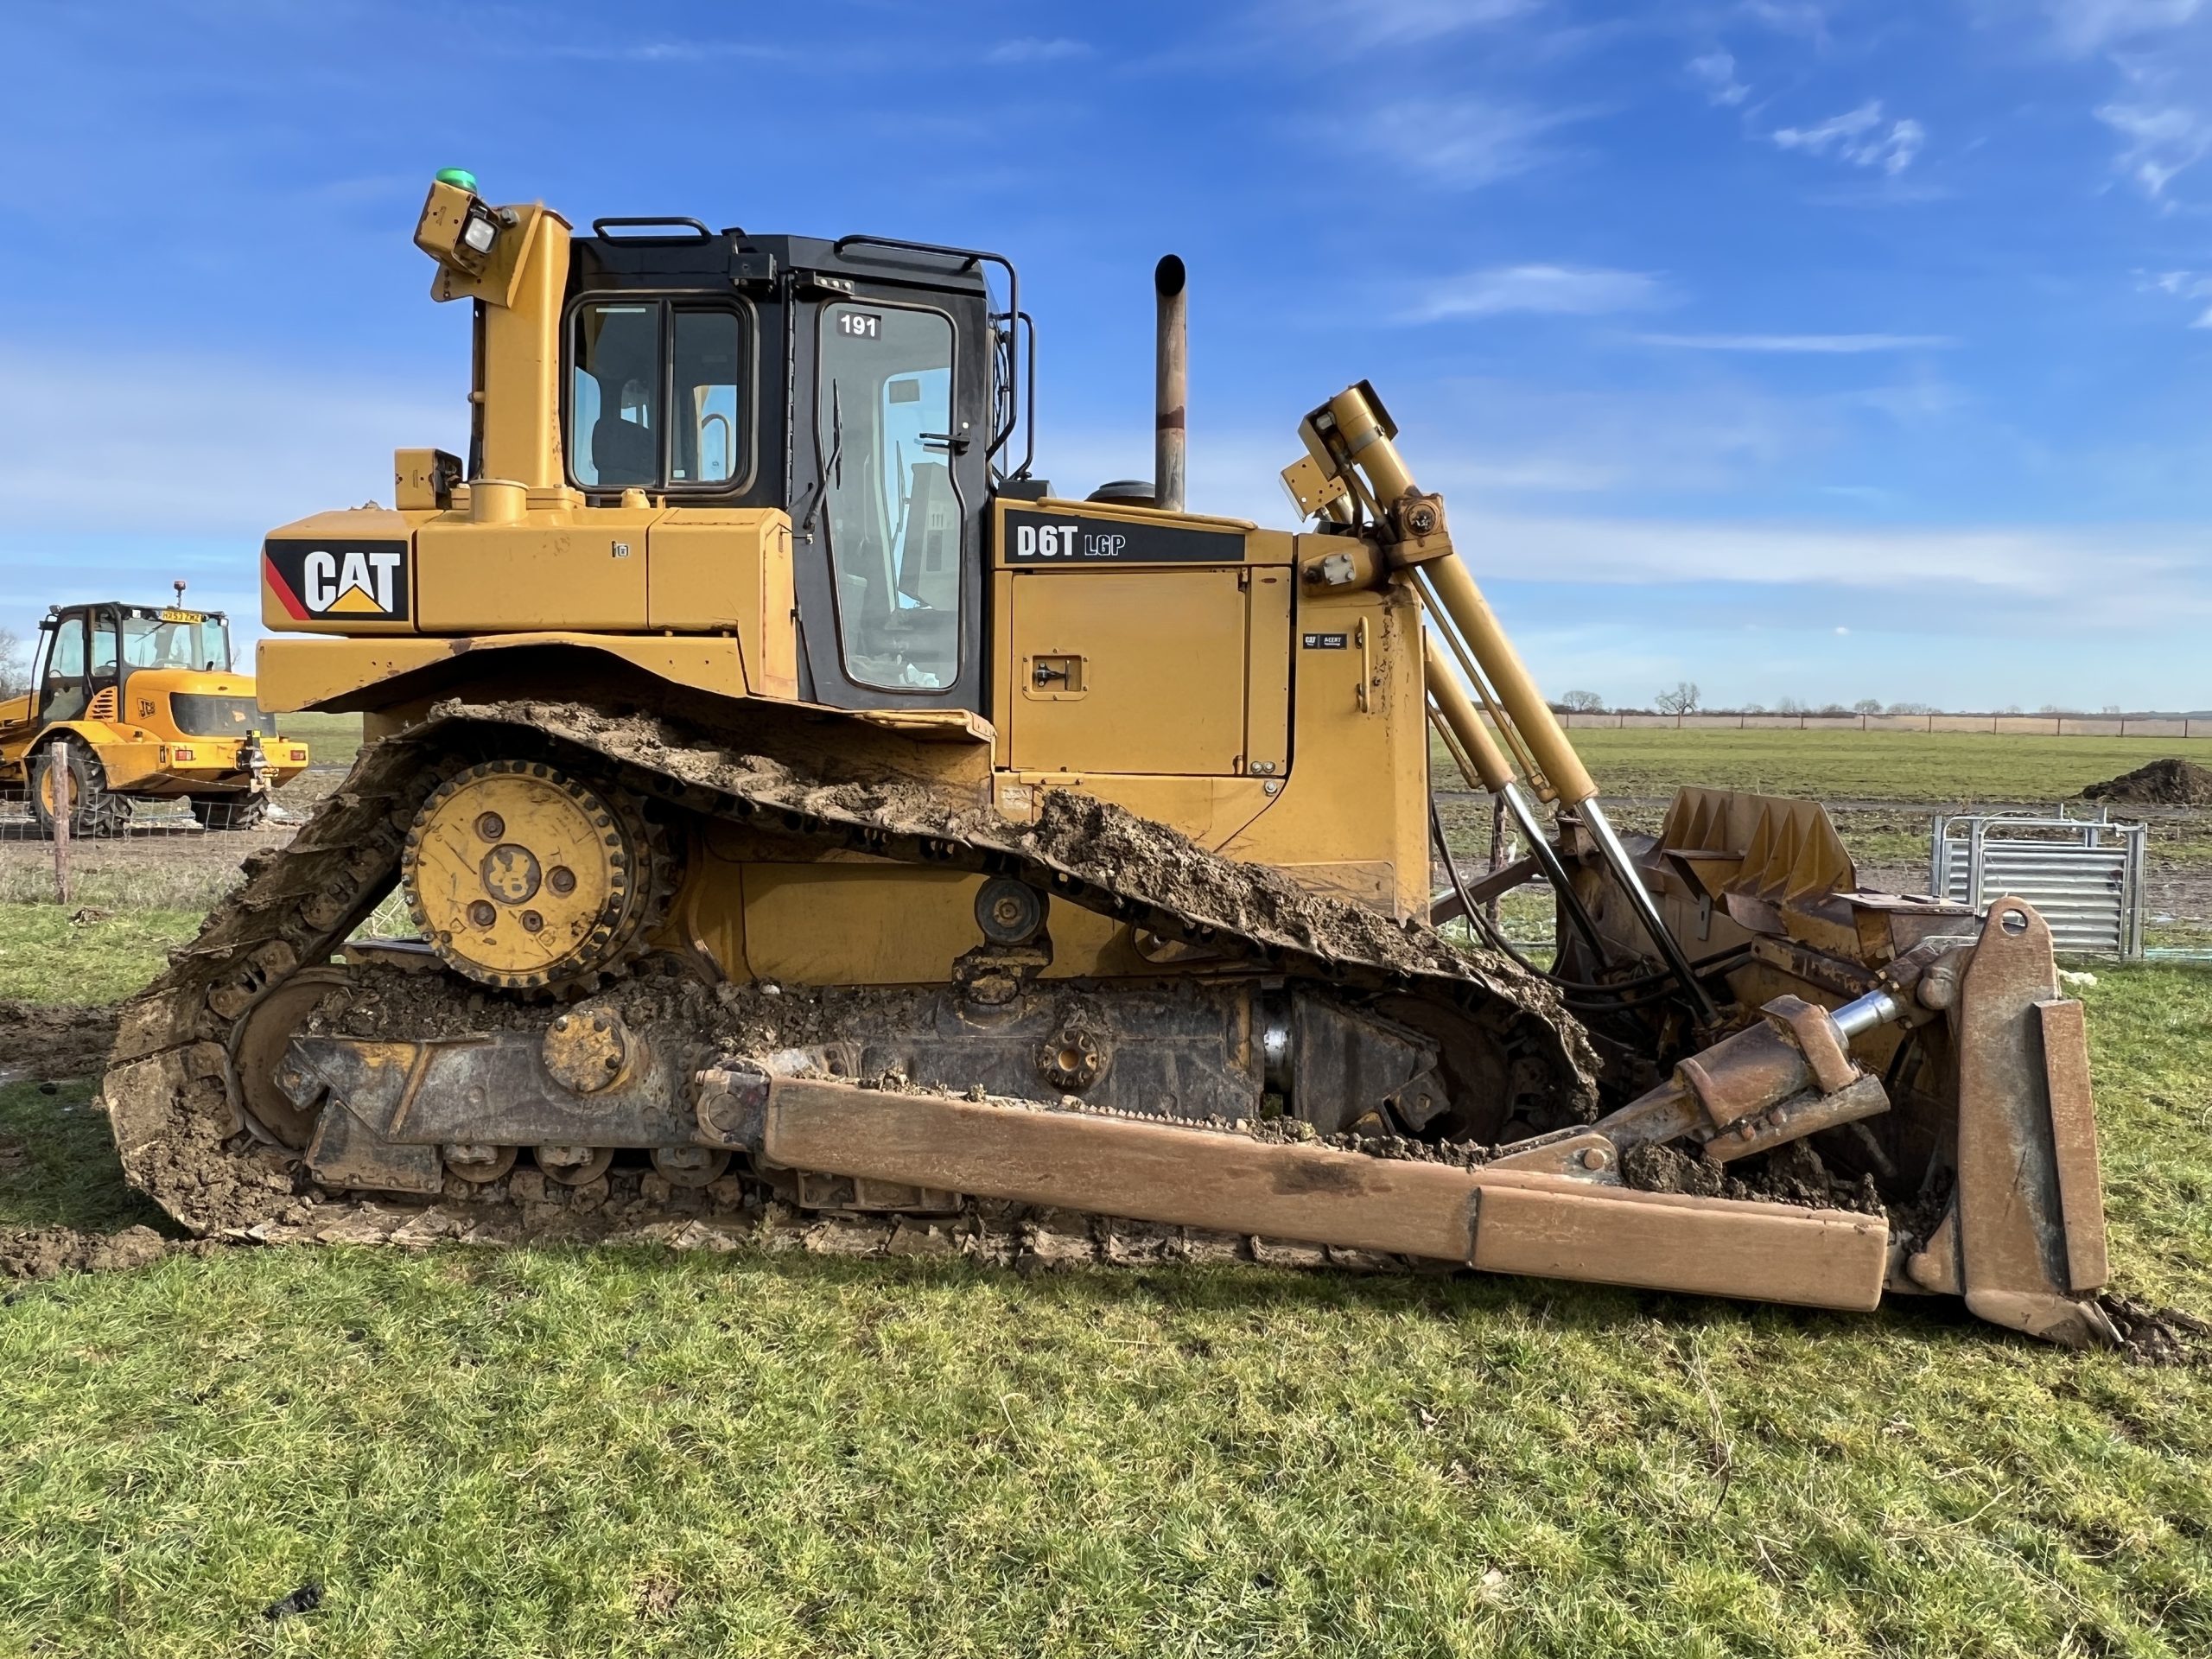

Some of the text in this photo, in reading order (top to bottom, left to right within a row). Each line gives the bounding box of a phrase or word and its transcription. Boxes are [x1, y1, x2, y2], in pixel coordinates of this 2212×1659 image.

[841, 315, 874, 337] 191
[1017, 525, 1125, 556] D6T LGP
[304, 551, 400, 613] CAT
